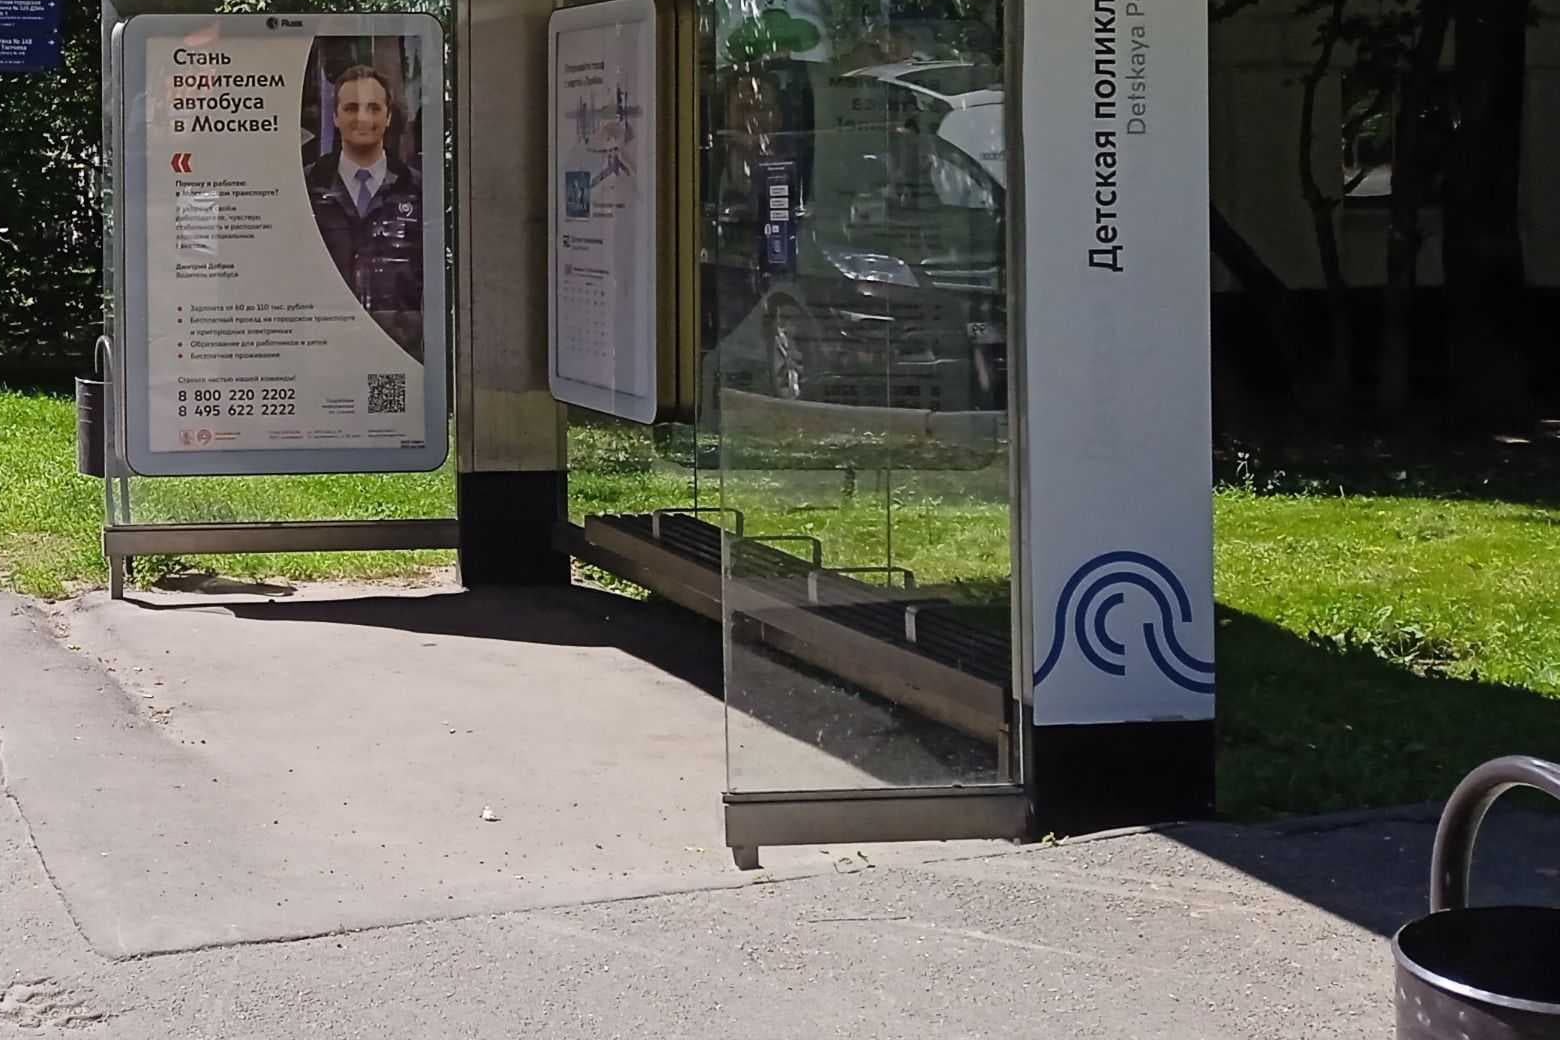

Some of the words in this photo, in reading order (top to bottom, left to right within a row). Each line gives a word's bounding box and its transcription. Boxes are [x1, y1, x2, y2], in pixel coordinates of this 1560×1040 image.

[173, 48, 231, 66] Стань
[173, 74, 285, 90] водителем
[1126, 24, 1150, 135] Detskaya
[173, 93, 265, 113] автобуса
[174, 120, 185, 133] в
[191, 115, 279, 133] Москве!
[1088, 130, 1124, 273] Детская
[178, 390, 187, 402] 8
[194, 389, 222, 402] 800
[229, 389, 255, 401] 220
[261, 388, 296, 401] 2202
[178, 405, 187, 417] 8
[194, 404, 221, 417] 495
[228, 404, 254, 416] 622
[261, 403, 296, 416] 2222
